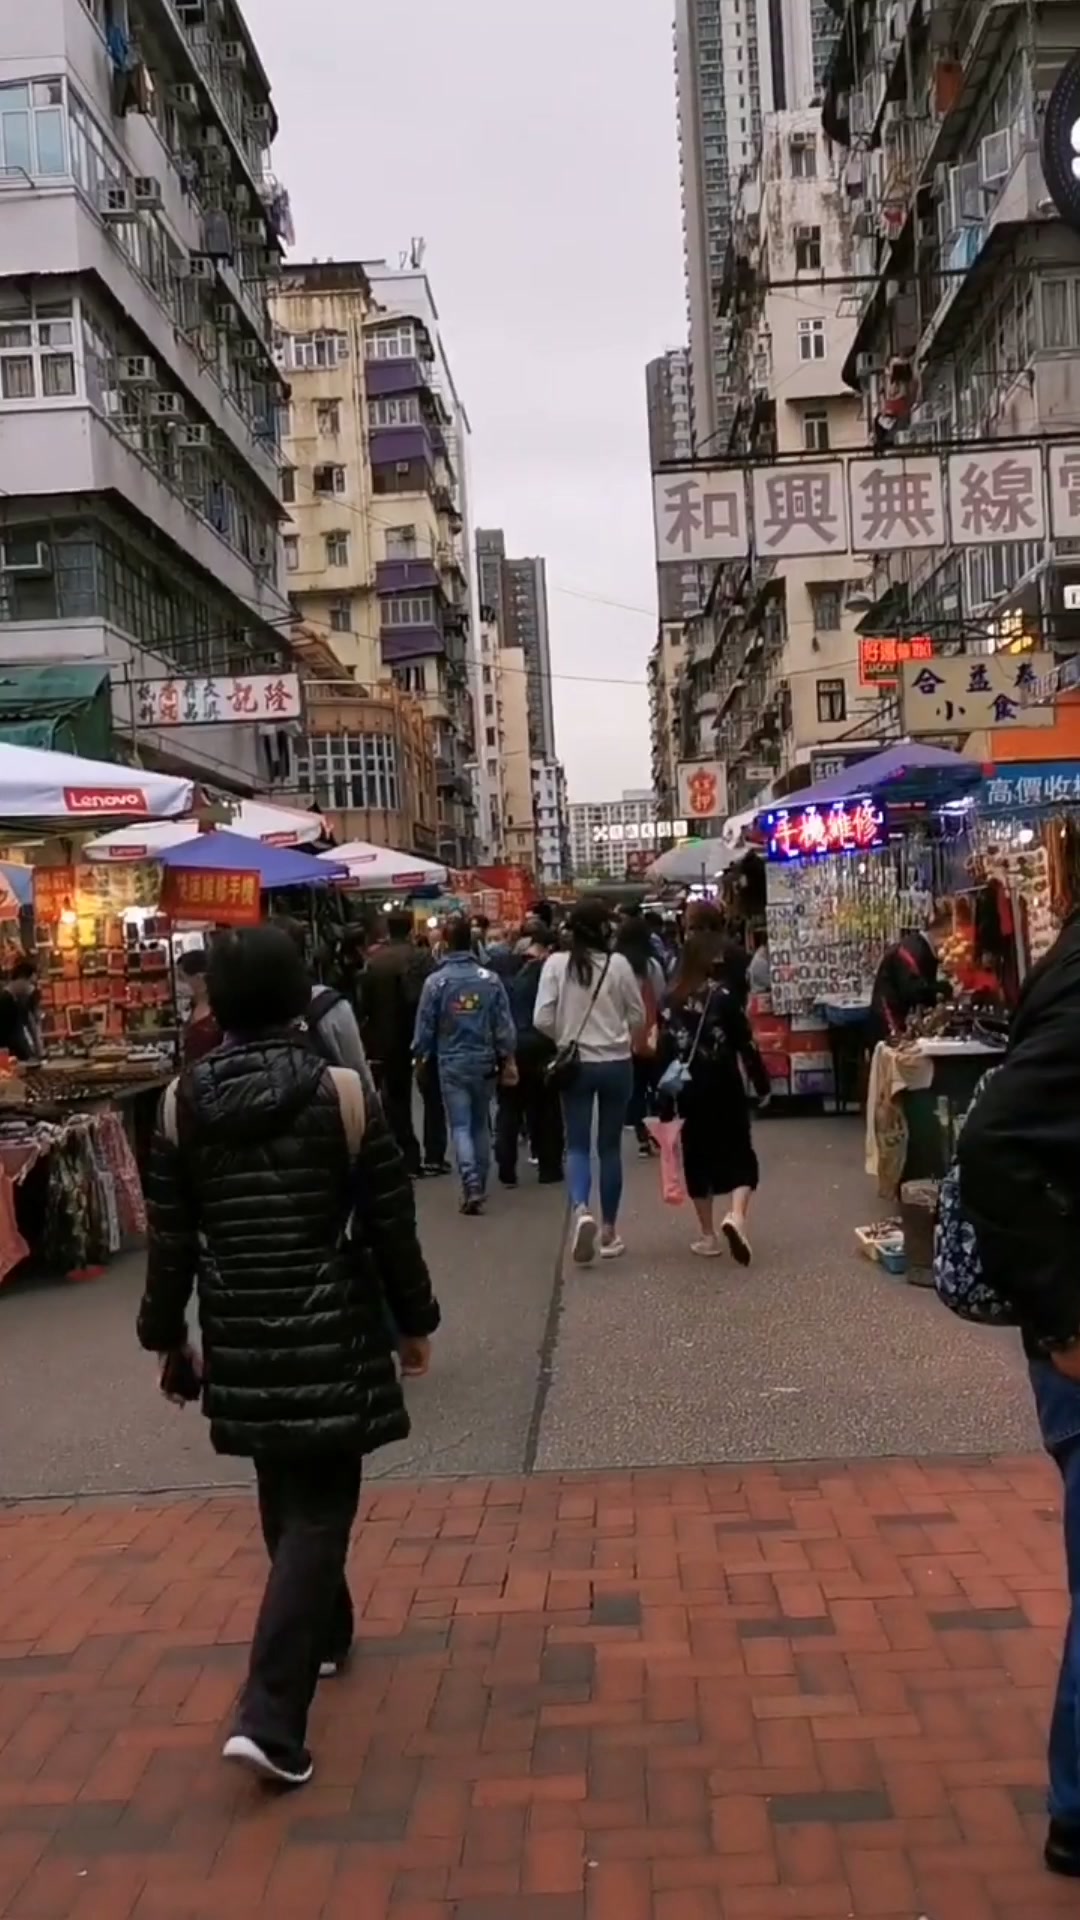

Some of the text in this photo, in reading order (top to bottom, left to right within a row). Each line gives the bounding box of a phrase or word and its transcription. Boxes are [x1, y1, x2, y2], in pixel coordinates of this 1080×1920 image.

[664, 453, 1080, 553] 和興無線
[936, 693, 1020, 722] 小食
[70, 791, 138, 808] Lenovo
[774, 807, 878, 858] 手機維修
